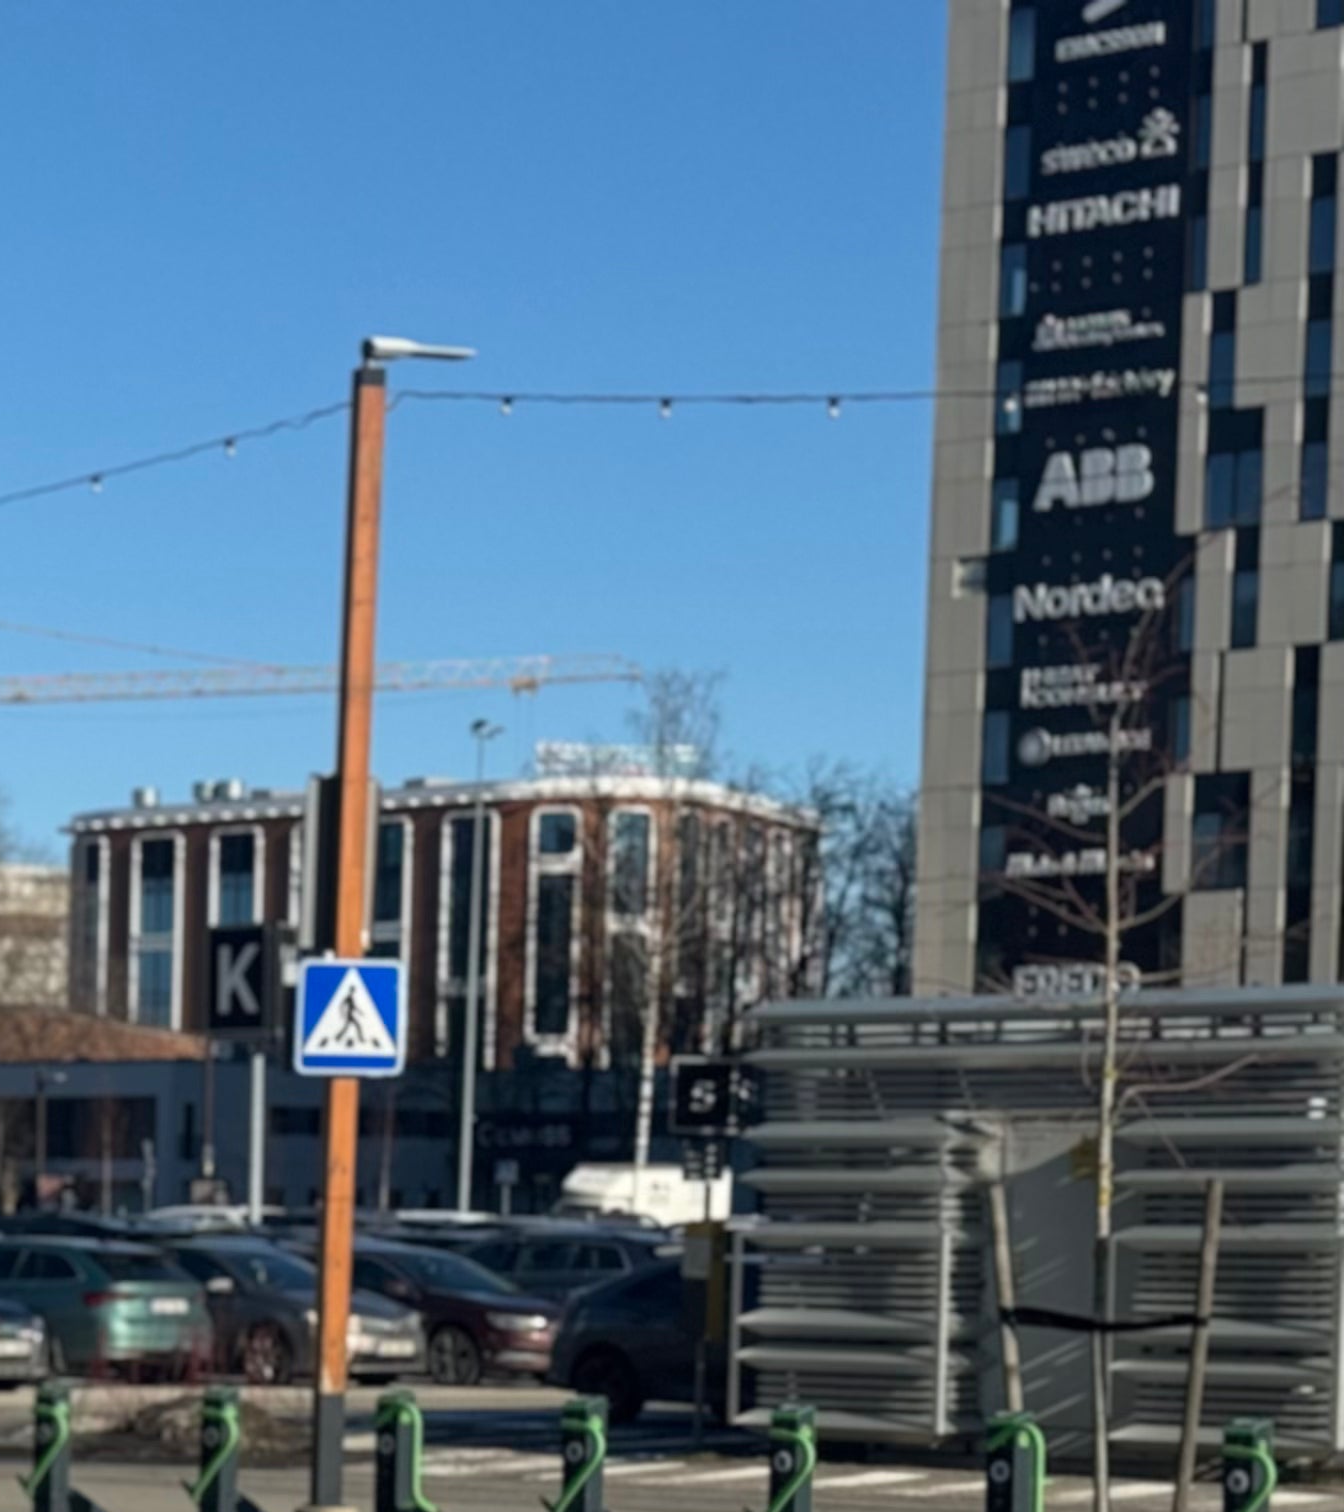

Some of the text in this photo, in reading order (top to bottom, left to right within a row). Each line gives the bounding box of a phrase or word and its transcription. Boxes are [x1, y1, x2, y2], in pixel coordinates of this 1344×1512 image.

[1027, 184, 1180, 237] HITACHI
[1032, 443, 1155, 513] ABB
[1014, 572, 1165, 624] Nordea
[216, 942, 260, 1016] K
